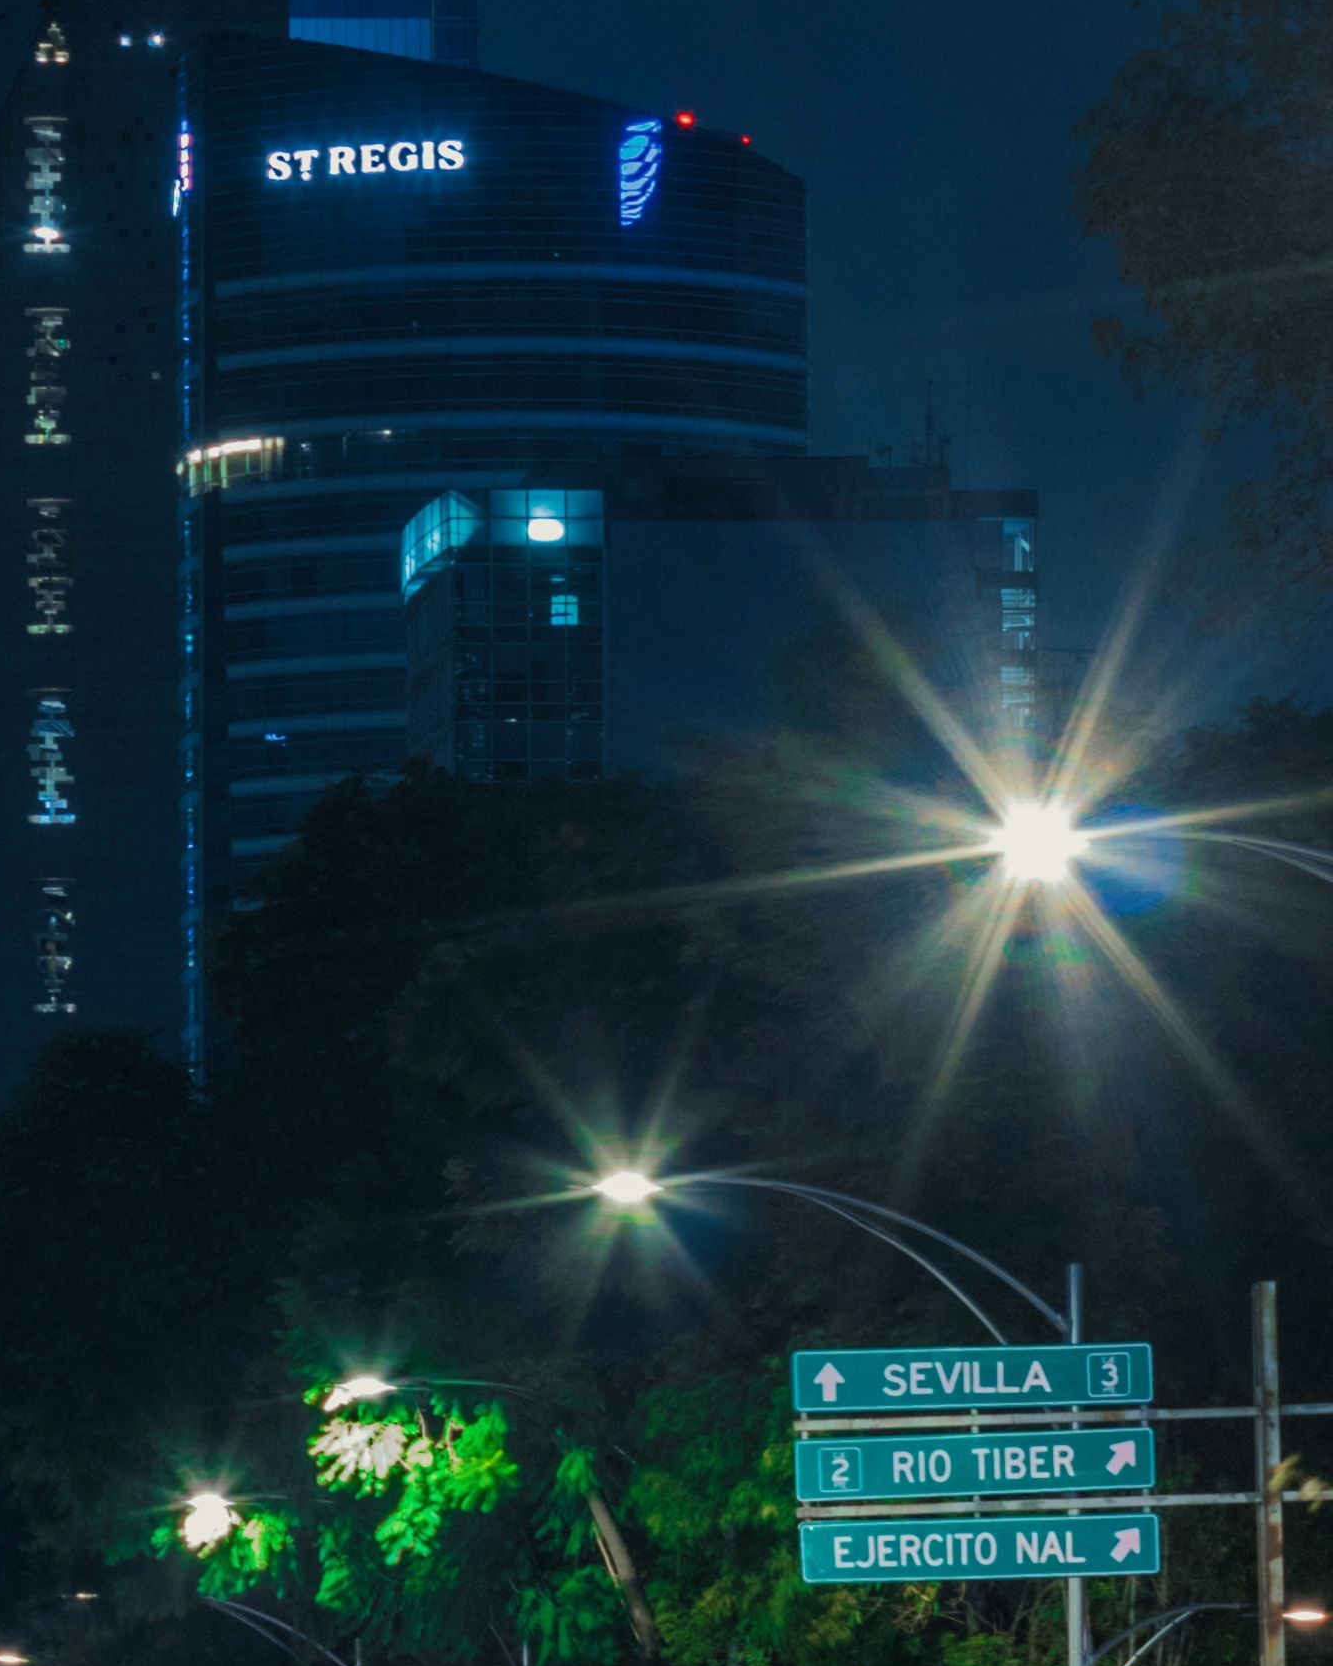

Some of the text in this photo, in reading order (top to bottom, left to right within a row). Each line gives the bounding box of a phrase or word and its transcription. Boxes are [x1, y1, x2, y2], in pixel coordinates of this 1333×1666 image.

[328, 140, 466, 175] REGIS
[882, 1360, 1119, 1397] SEVILLA 3
[831, 1445, 1075, 1484] 2 RIO TIBER
[833, 1530, 1087, 1569] EJERCITO NAL
